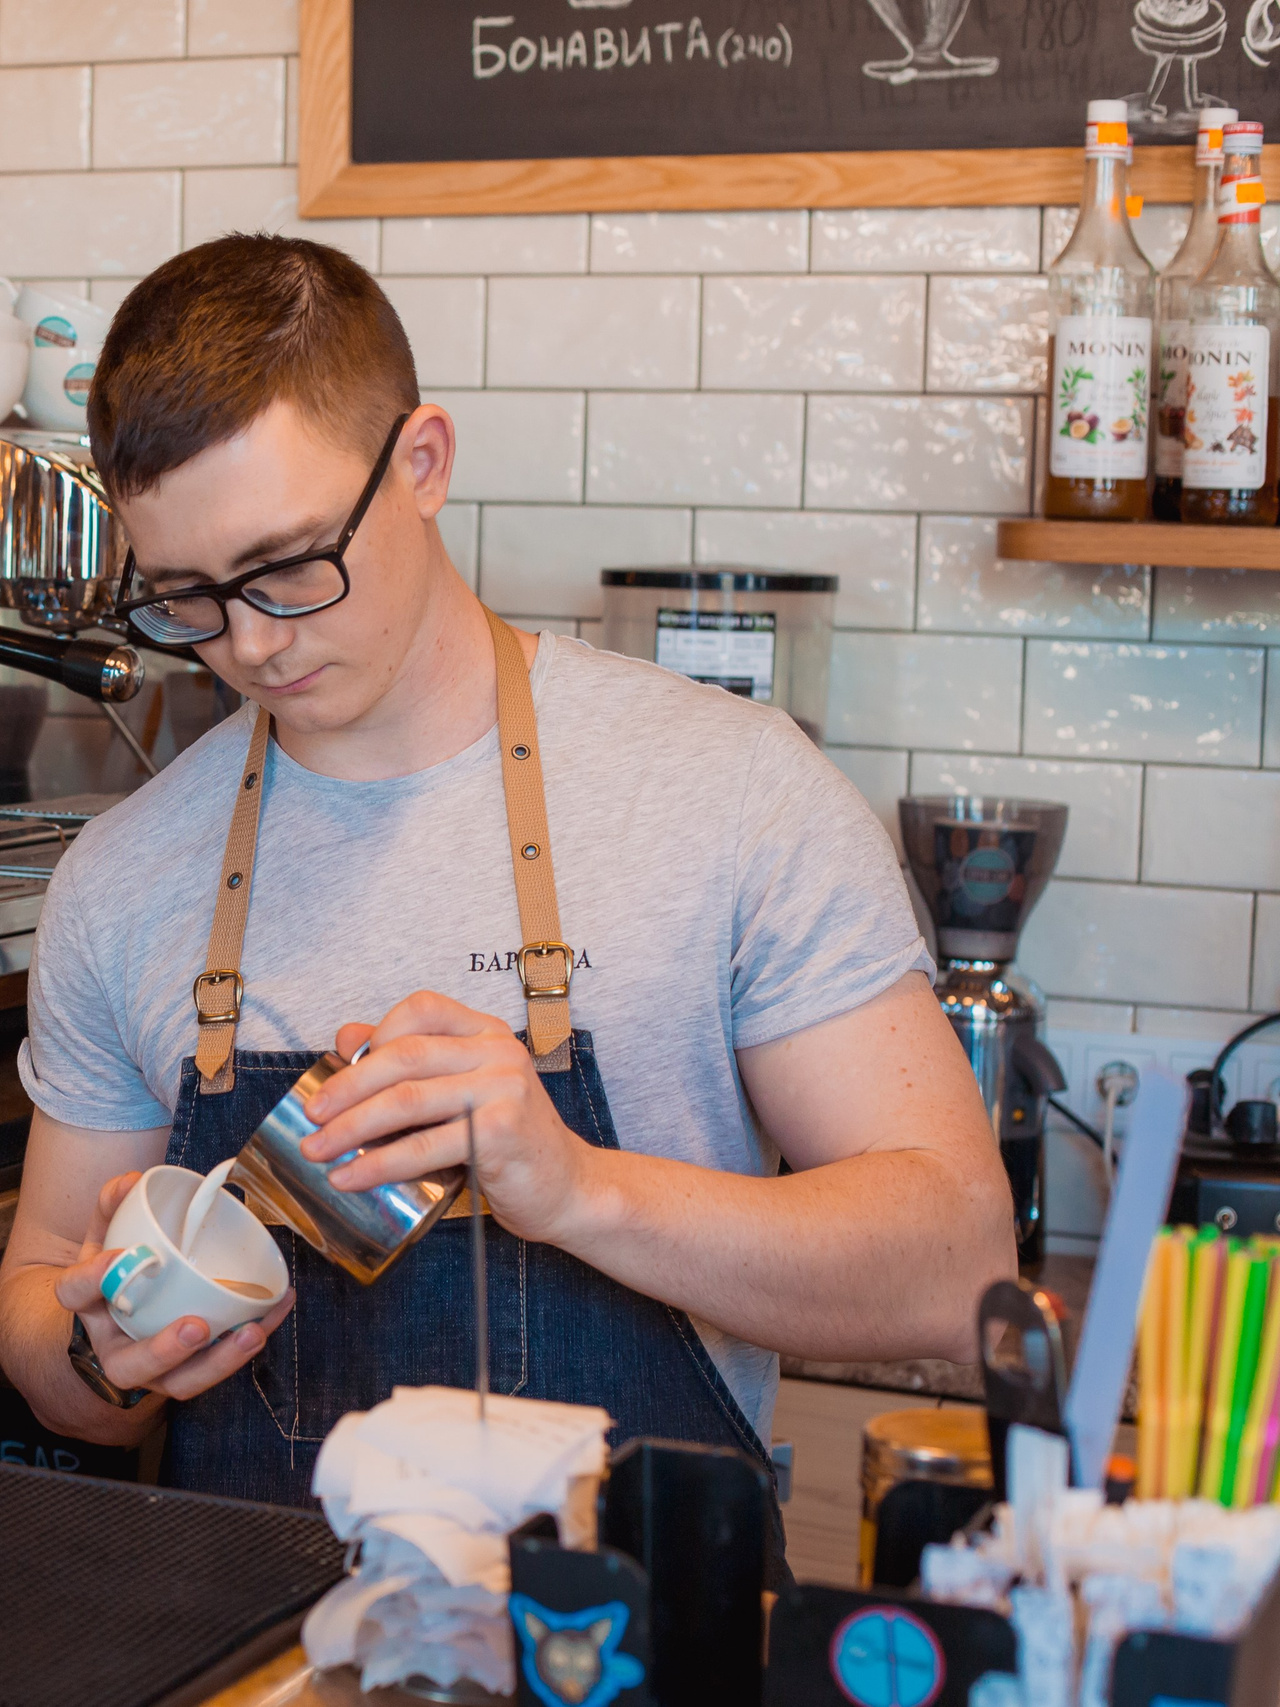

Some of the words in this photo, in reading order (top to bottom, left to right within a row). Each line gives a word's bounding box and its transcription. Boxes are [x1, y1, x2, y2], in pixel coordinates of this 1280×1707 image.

[472, 15, 711, 79] БОНАВИТА
[718, 22, 793, 68] (240)
[1069, 340, 1146, 359] MONIN
[468, 948, 593, 973] БАРА
